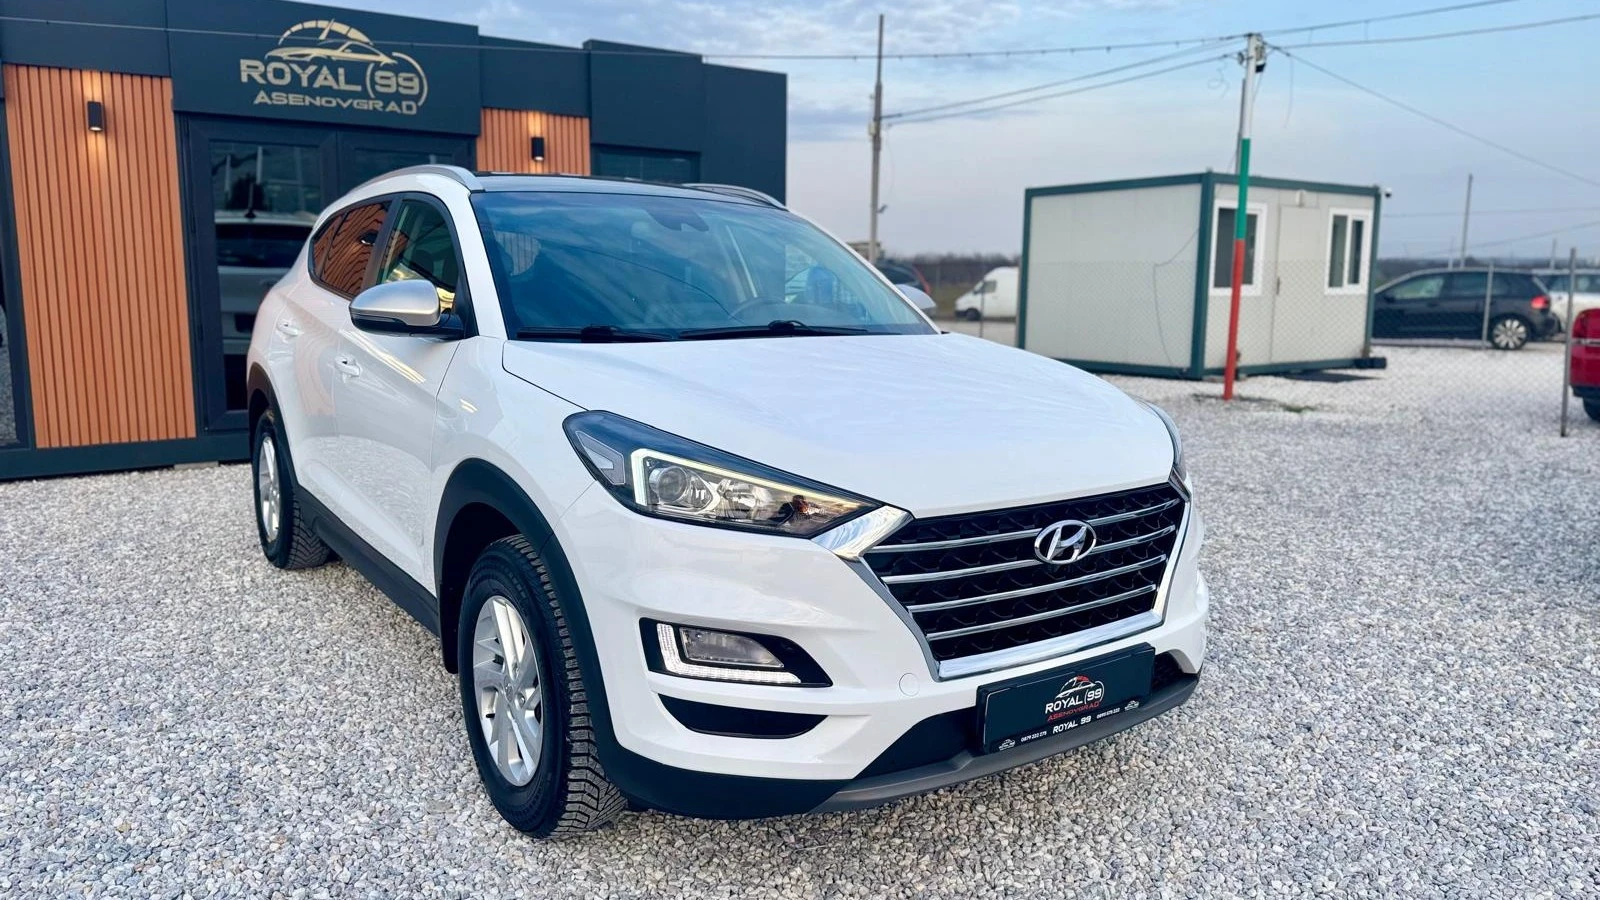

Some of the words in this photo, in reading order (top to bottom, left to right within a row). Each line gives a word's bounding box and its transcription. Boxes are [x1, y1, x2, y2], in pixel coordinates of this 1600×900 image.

[239, 58, 362, 92] ROYAL
[253, 90, 417, 115] ASENOVGRAD
[1045, 695, 1083, 714] ROYAL
[1047, 701, 1100, 721] ASENOVGRAD
[1052, 720, 1078, 734] ROYAL
[1080, 715, 1092, 725] 99
